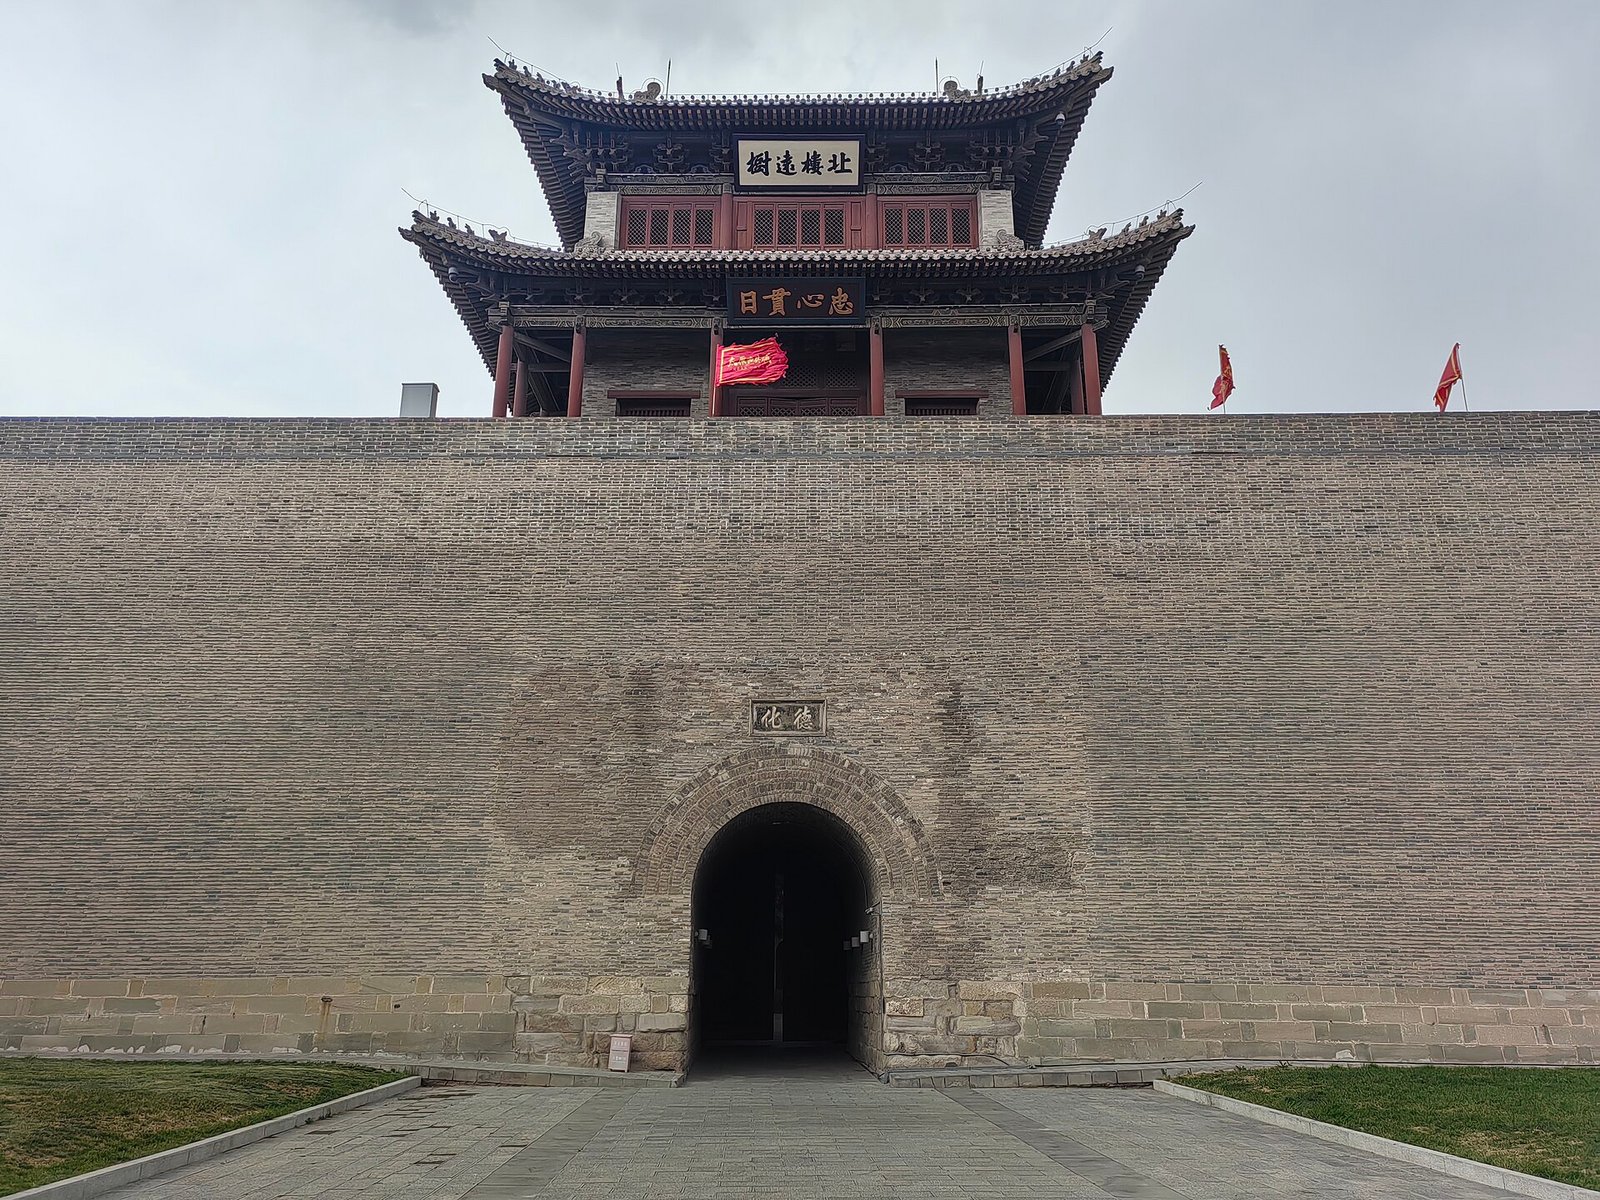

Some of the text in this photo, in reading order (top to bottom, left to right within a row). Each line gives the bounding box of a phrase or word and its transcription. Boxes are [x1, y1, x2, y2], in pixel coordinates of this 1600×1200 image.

[740, 287, 854, 316] 忠心貫日
[760, 705, 814, 730] 德化
